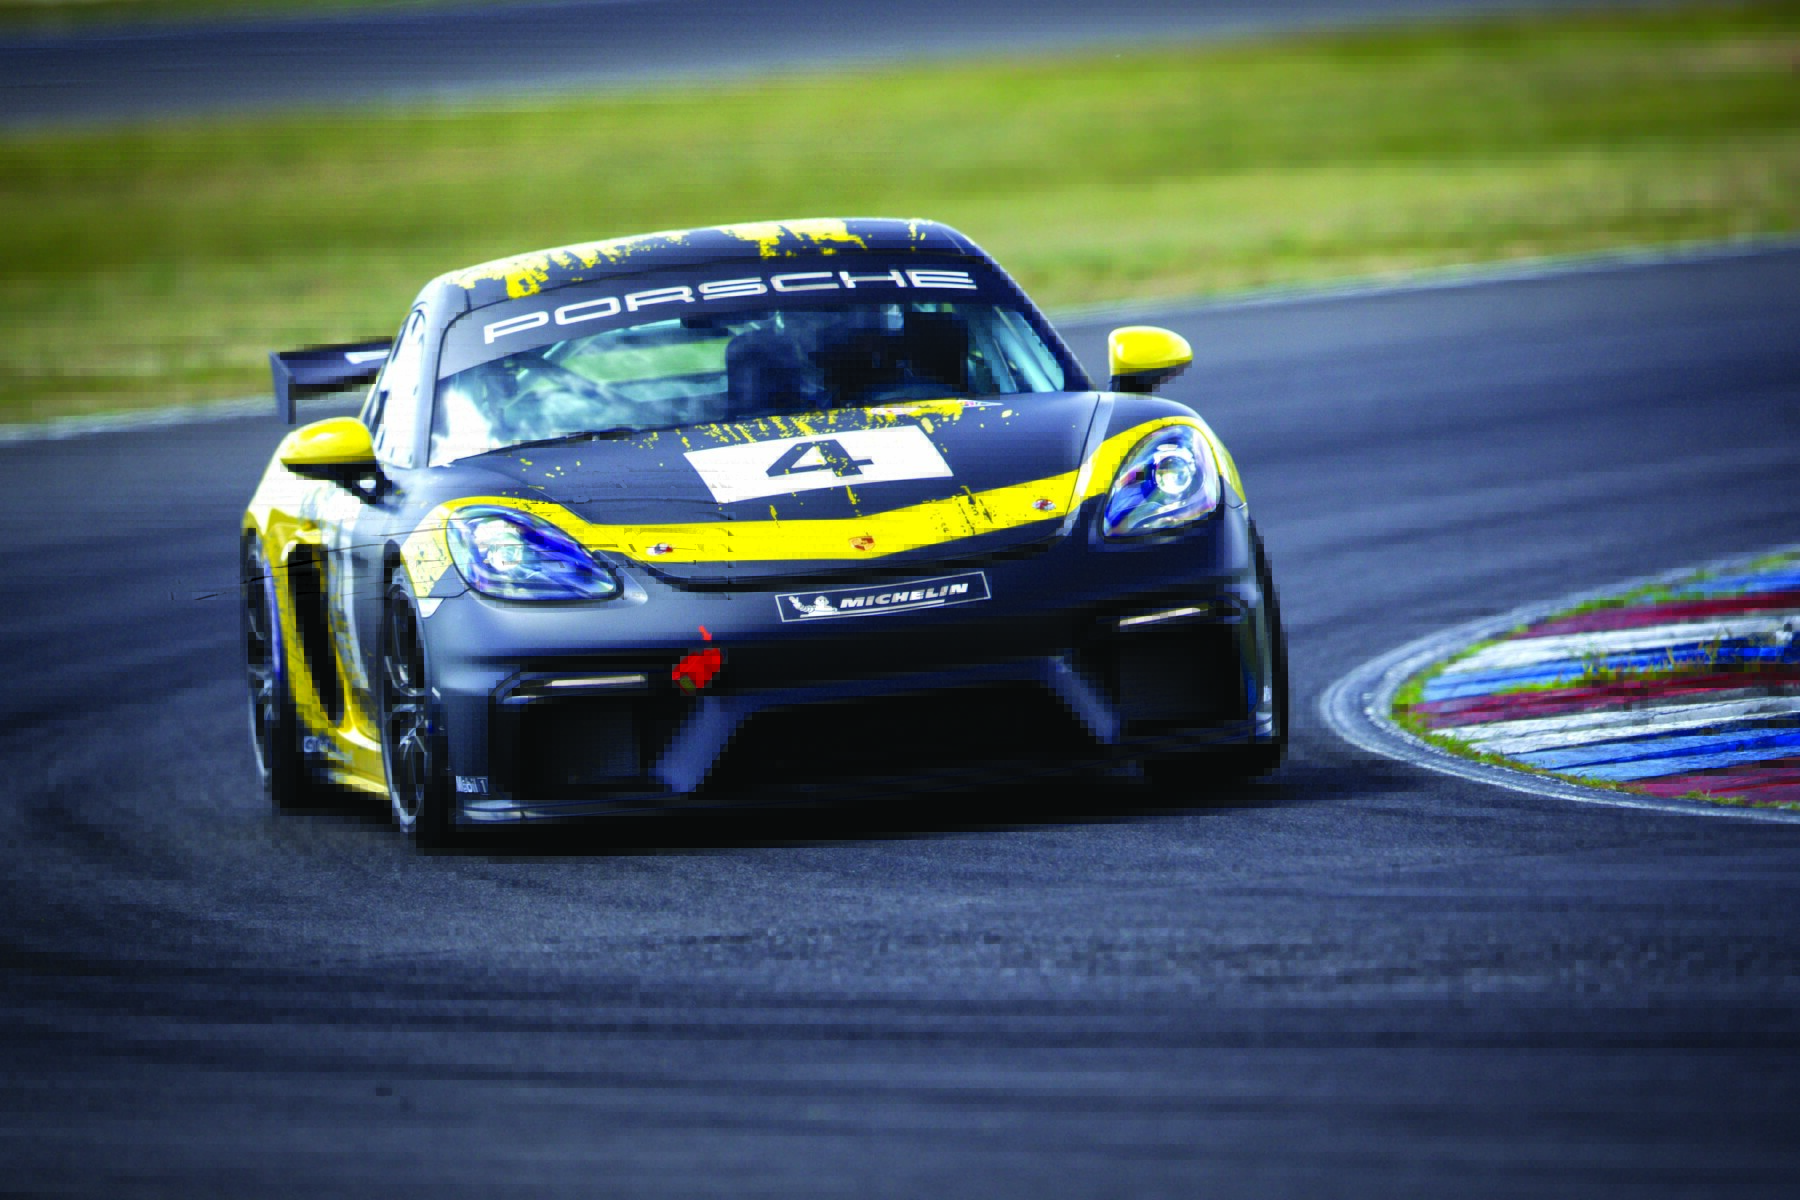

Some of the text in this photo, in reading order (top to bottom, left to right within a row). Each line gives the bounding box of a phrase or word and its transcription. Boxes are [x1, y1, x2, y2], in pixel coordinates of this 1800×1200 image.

[484, 269, 977, 344] PORSCHE
[766, 439, 874, 477] 4
[840, 583, 969, 608] MICHELIN
